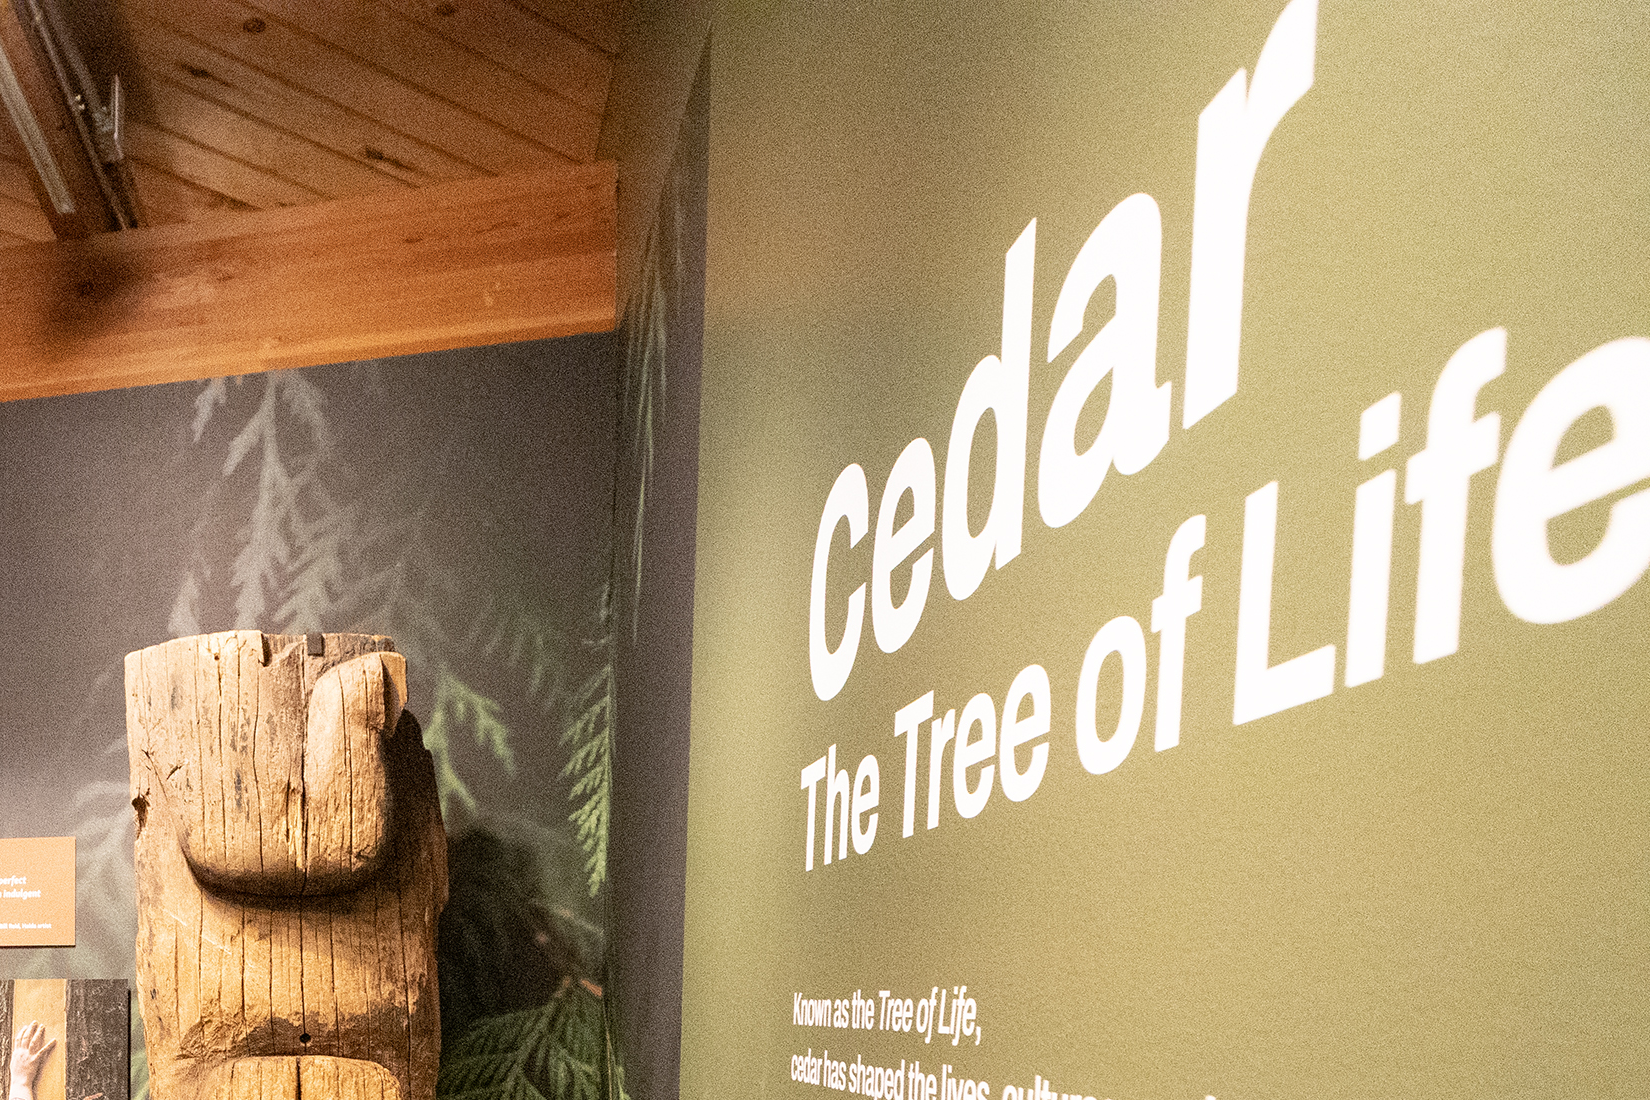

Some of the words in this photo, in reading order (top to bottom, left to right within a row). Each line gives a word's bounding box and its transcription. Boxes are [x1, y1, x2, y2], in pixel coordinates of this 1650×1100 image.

[809, 0, 1318, 701] Cedar
[800, 744, 880, 872] The
[894, 664, 1052, 839] Tree
[1075, 514, 1207, 775] of
[1233, 325, 1650, 726] Life
[3, 888, 41, 900] indulgent
[793, 992, 831, 1027] Known
[834, 998, 849, 1029] as
[852, 989, 875, 1030] the
[878, 990, 914, 1033] Tree
[917, 986, 938, 1043] of
[937, 985, 982, 1046] Life,
[791, 1048, 822, 1085] cedar
[823, 1050, 846, 1091] has
